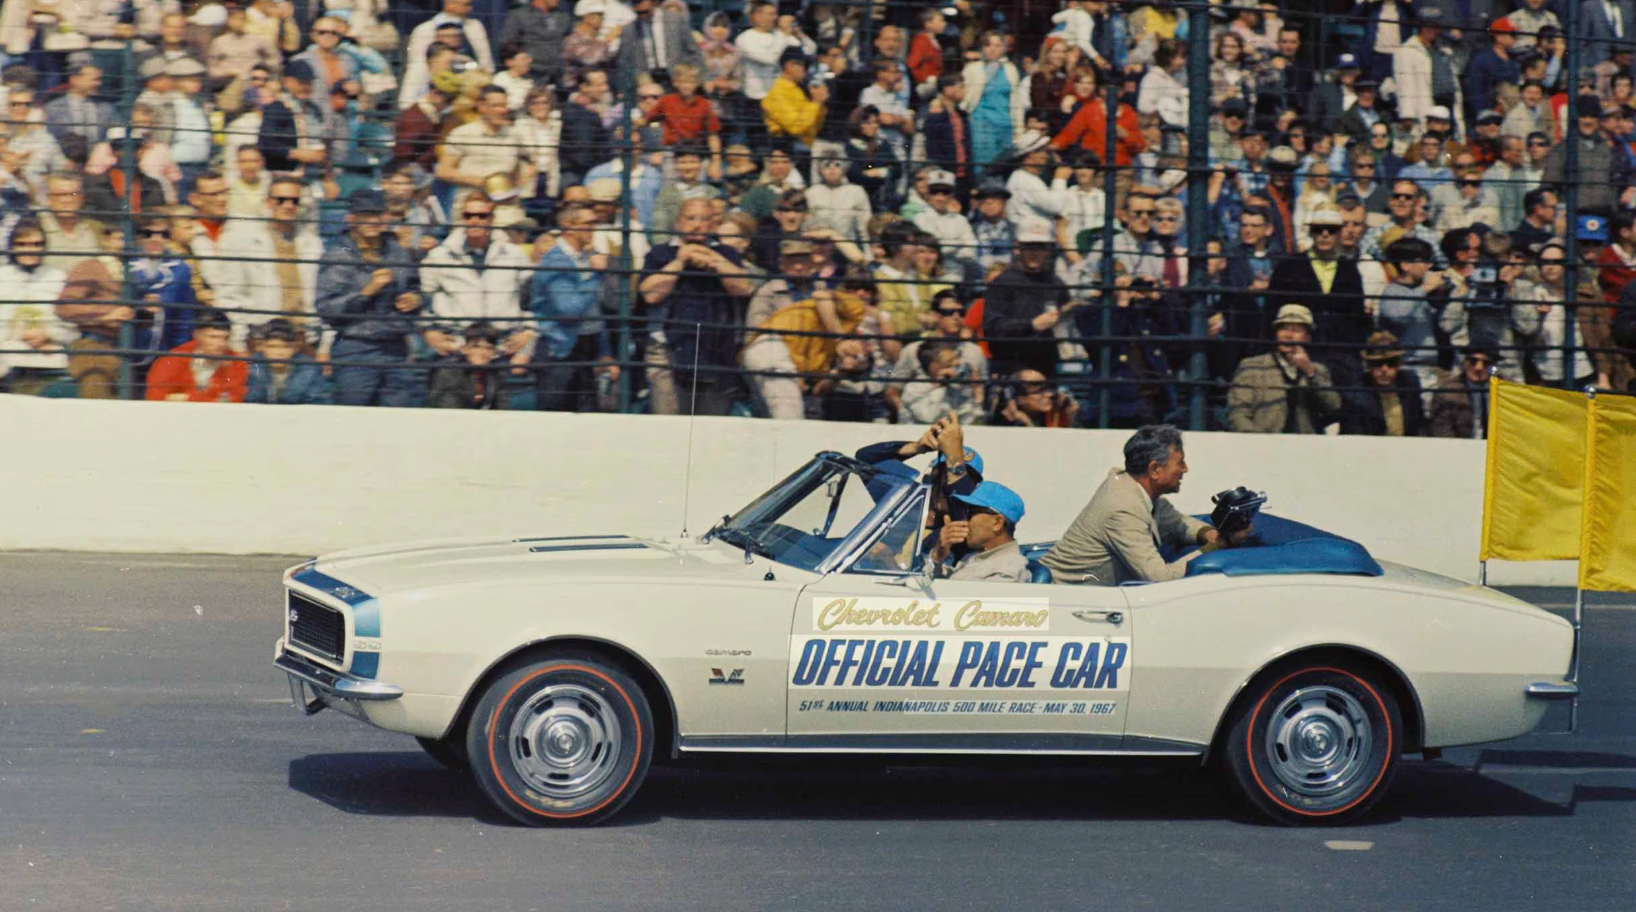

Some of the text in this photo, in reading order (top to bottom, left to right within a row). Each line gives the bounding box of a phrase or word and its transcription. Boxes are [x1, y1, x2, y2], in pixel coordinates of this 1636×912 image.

[817, 598, 1048, 632] Chevrolet Camaro
[792, 639, 1128, 689] OFFICIAL PACE CAR
[826, 701, 869, 712] ANNUAL
[873, 701, 950, 713] INDIANAPOLIS
[952, 702, 976, 713] 500
[977, 702, 1006, 713] MILE
[1089, 703, 1117, 714] 1967
